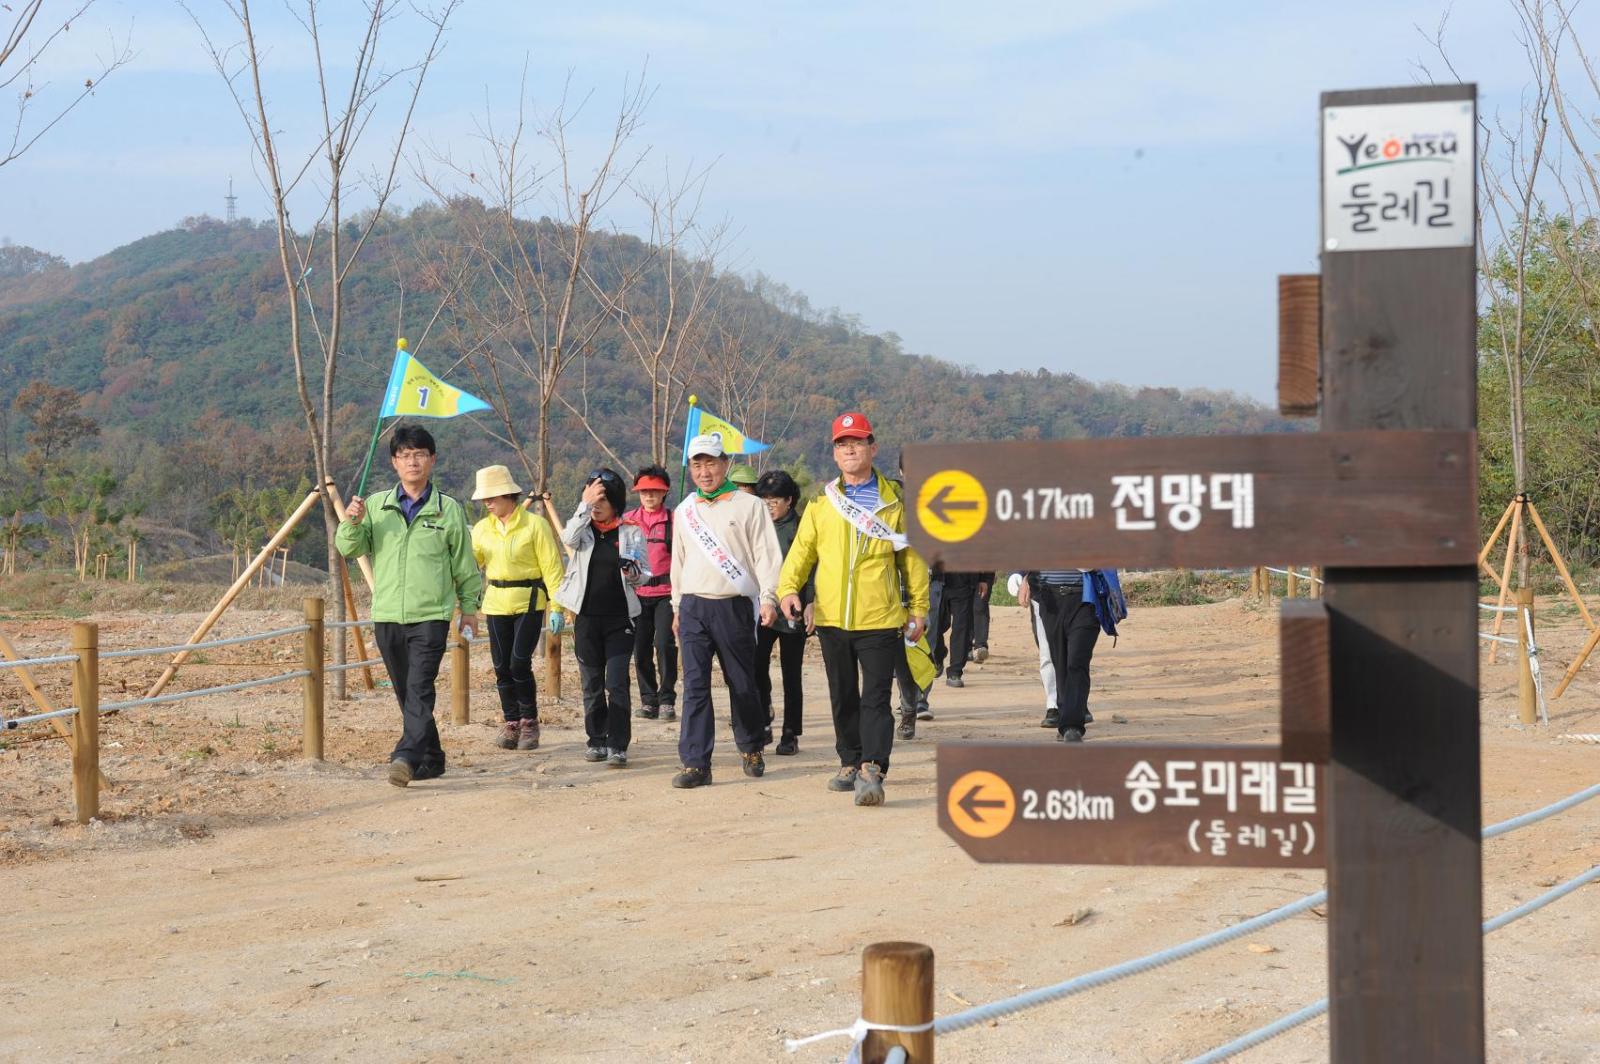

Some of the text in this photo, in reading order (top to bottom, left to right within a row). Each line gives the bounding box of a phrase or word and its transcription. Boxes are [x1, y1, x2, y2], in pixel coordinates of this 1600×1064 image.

[1337, 133, 1457, 166] Yeonsu
[1341, 177, 1454, 233] 둘레길
[418, 387, 430, 408] 1
[996, 473, 1254, 531] 0.17km 전망대
[1022, 760, 1317, 820] 2.63km 송도미래길
